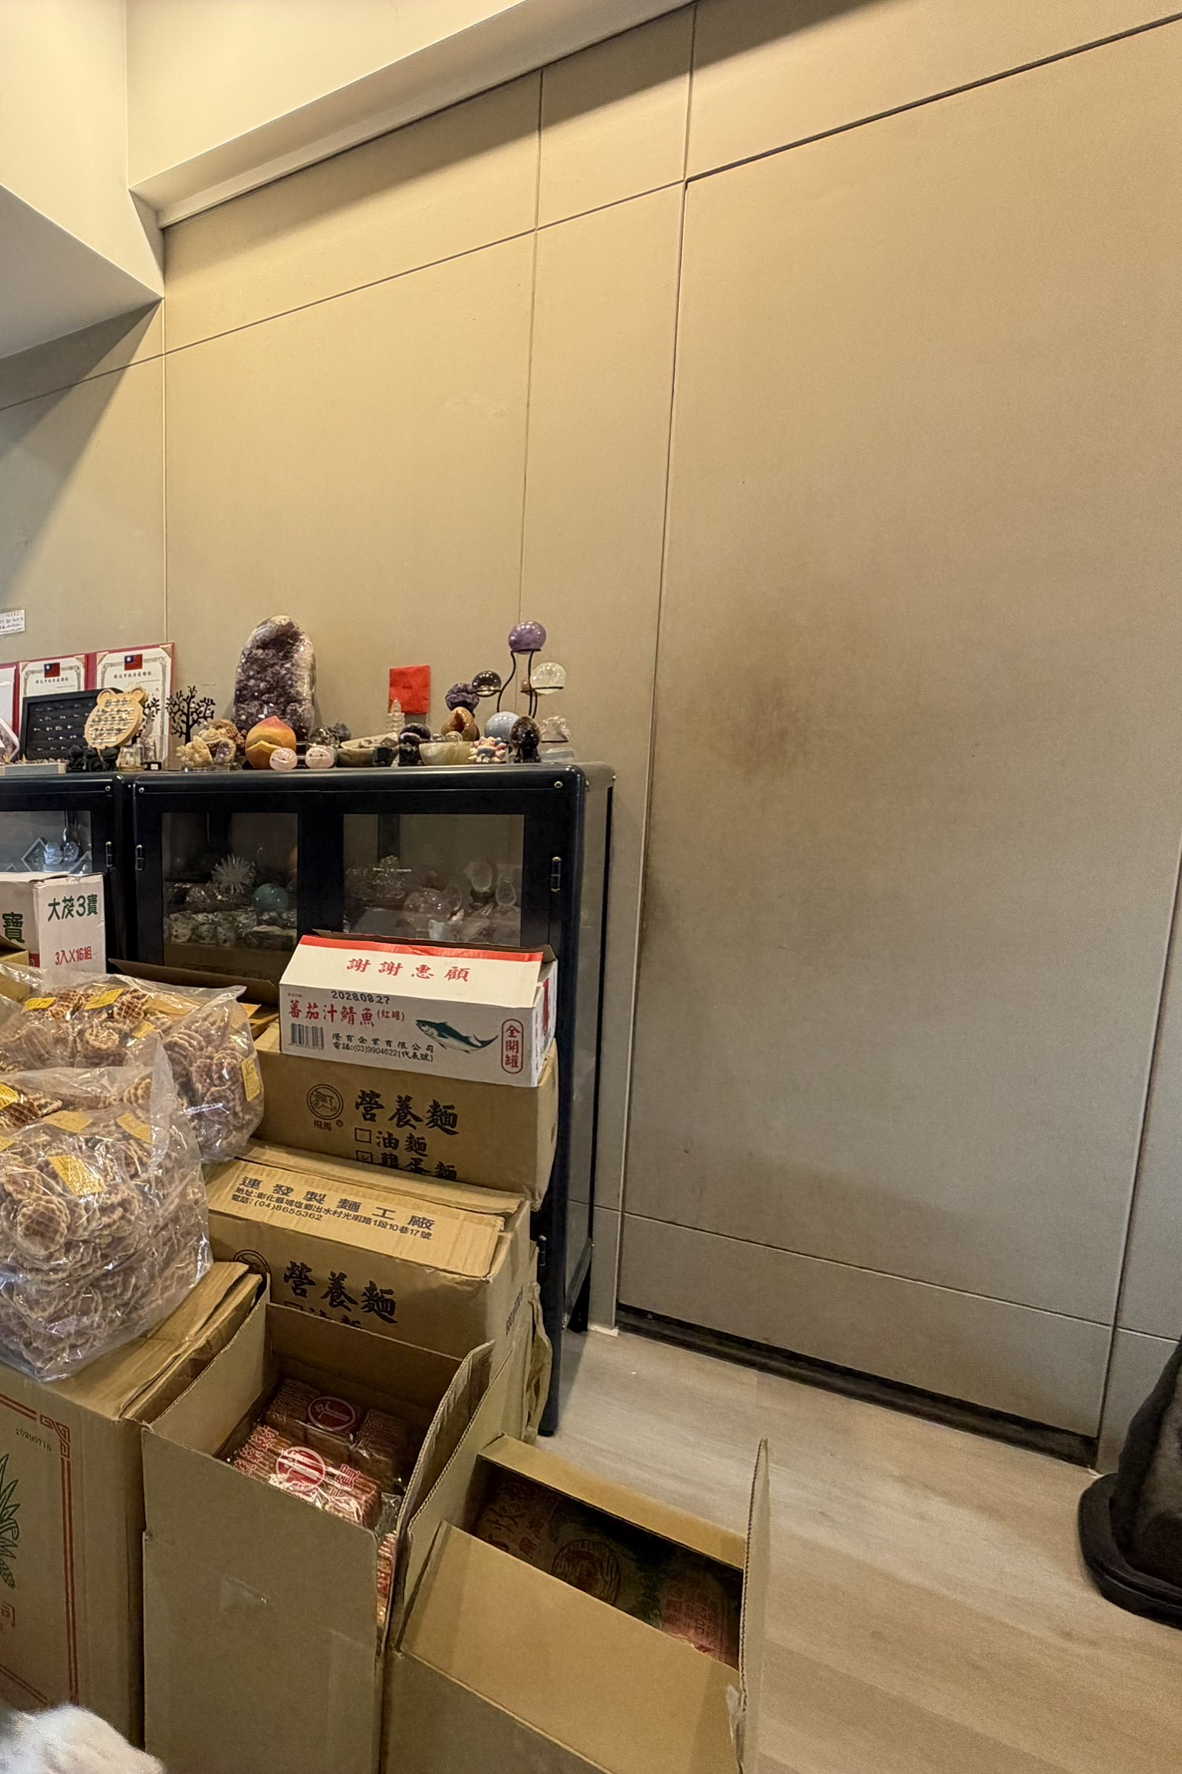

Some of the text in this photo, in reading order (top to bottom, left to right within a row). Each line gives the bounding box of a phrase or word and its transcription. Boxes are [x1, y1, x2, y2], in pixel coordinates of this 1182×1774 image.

[48, 893, 98, 922] 大茂3寶
[346, 957, 471, 983] 謝謝惠顧
[288, 999, 375, 1028] 蕃茄汁鯖魚
[504, 1024, 522, 1069] 全開罐
[354, 1089, 460, 1136] 營養麵
[375, 1130, 429, 1158] 油麵
[283, 1260, 399, 1324] 營養麵
